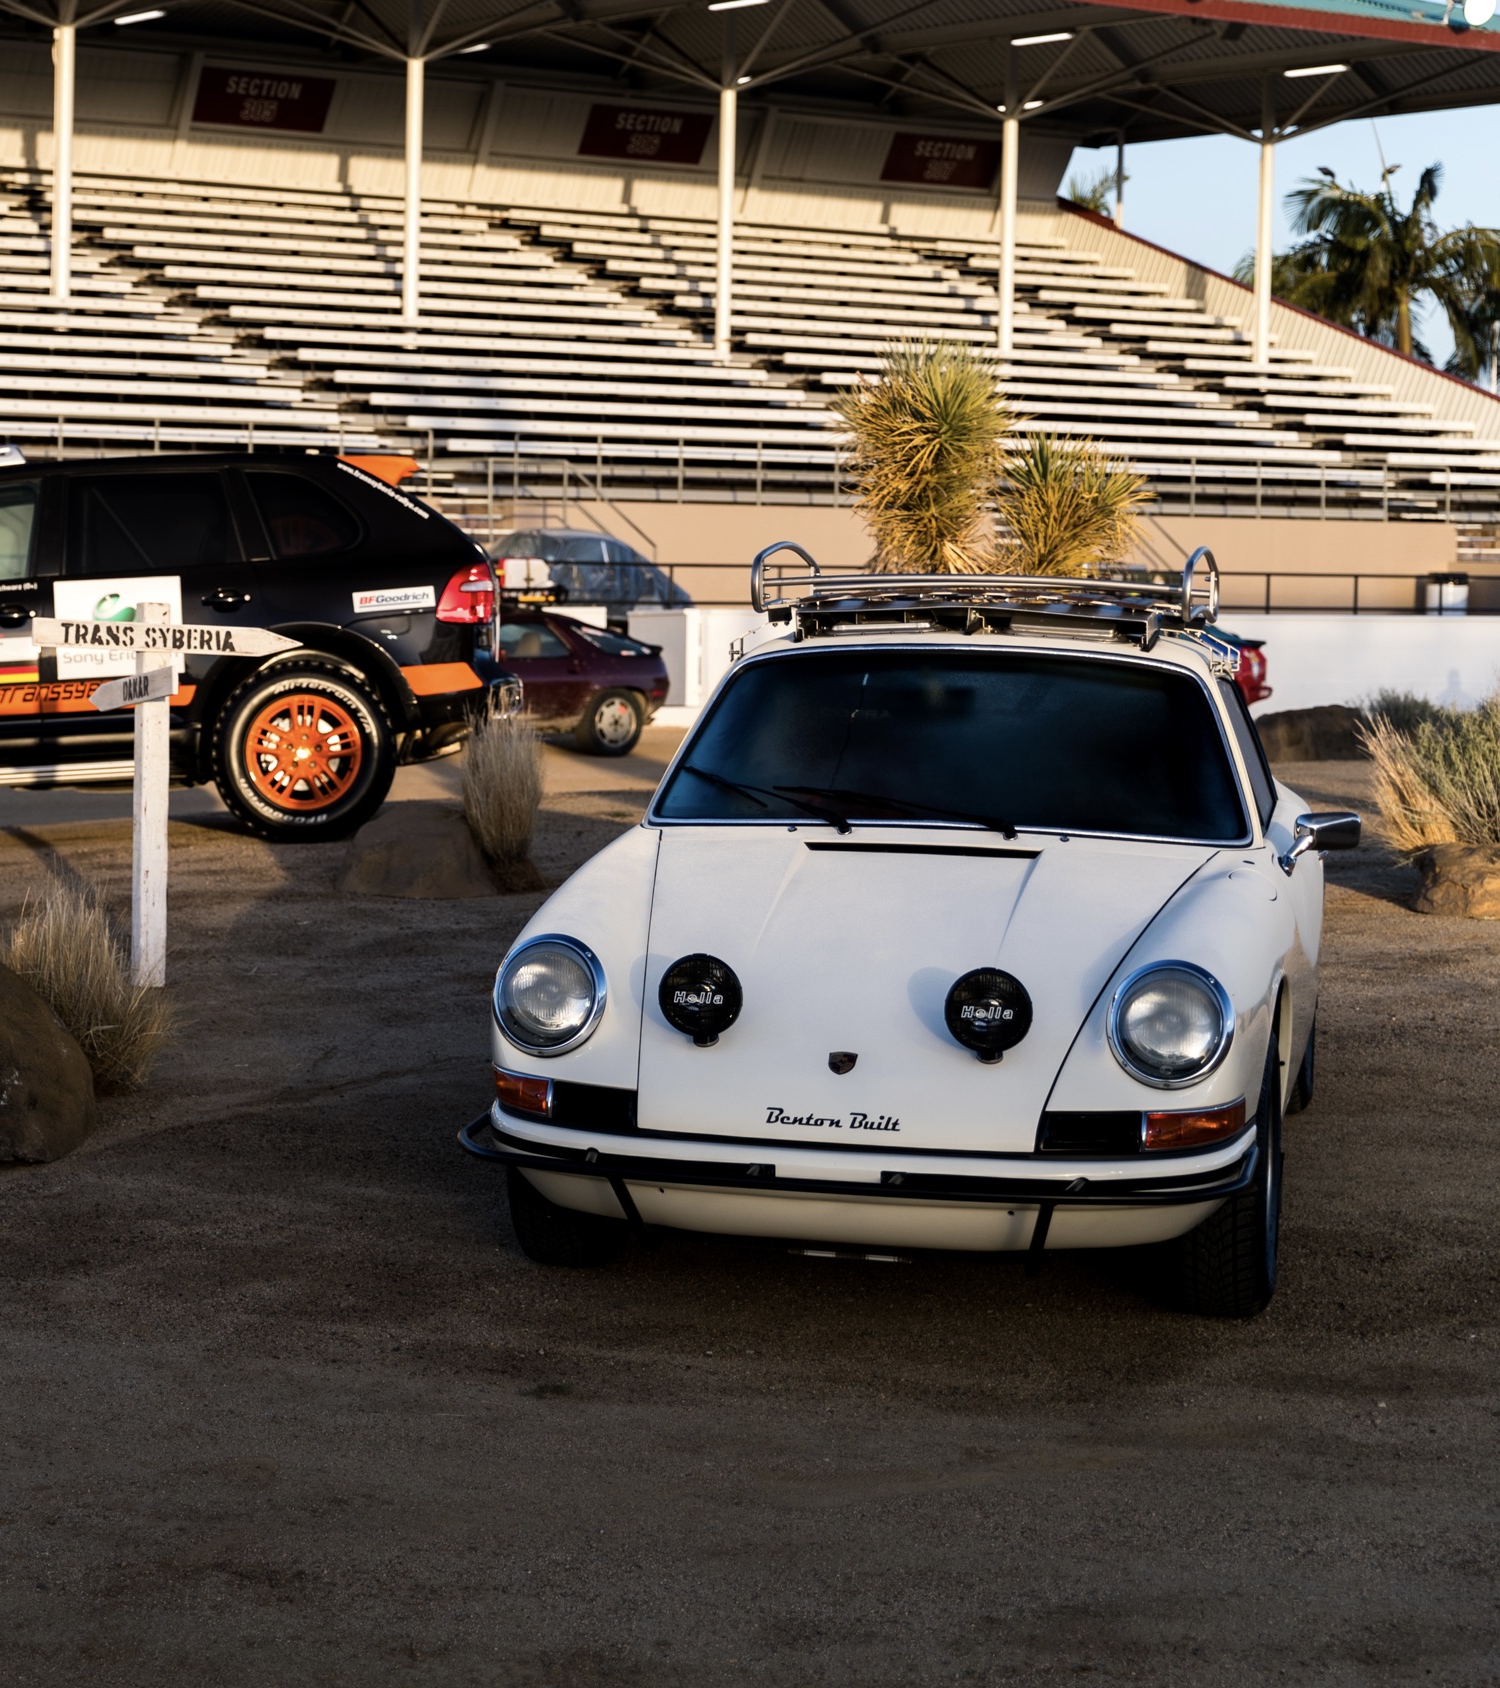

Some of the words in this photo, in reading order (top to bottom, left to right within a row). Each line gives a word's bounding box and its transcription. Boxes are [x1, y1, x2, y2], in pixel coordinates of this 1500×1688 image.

[226, 75, 302, 100] SECTION
[615, 112, 684, 135] SECTION
[914, 140, 977, 160] SECTION
[359, 592, 429, 605] BFGoodrich
[61, 622, 135, 647] TRANS
[145, 626, 236, 651] SYBERIA
[62, 651, 104, 665] Sony
[122, 675, 150, 702] DAKAR
[765, 1106, 843, 1128] Benton
[849, 1111, 901, 1132] Built
